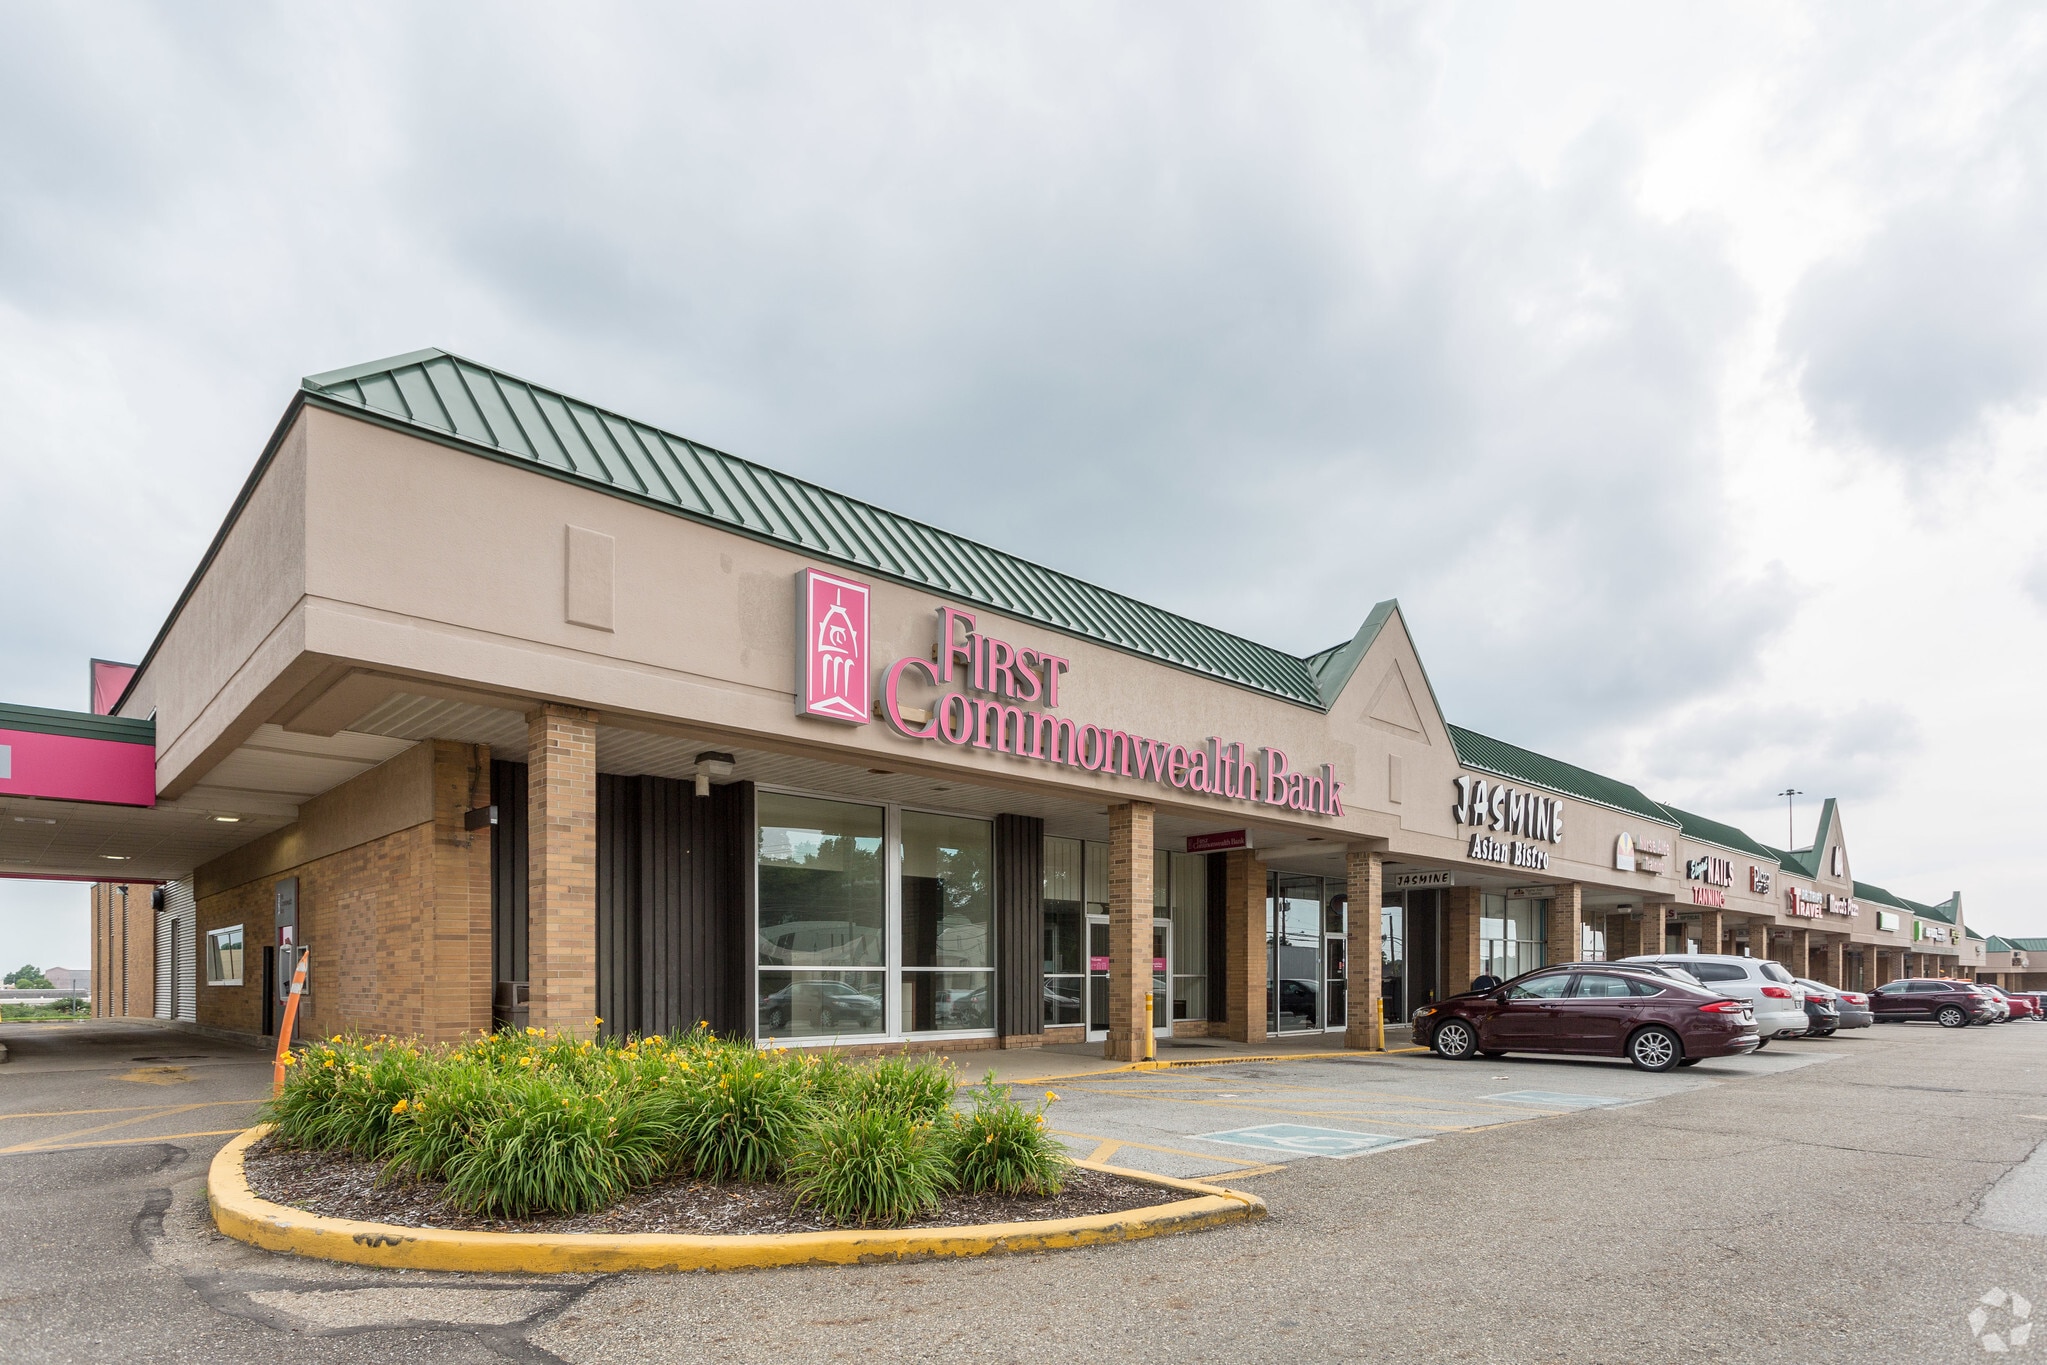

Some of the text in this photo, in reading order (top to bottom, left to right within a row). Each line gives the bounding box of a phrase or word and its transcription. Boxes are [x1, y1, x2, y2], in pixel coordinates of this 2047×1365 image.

[936, 605, 1070, 708] FIRST
[879, 655, 1347, 818] Commonwealth Bank
[1453, 774, 1564, 844] JASMINE
[1231, 837, 1245, 845] Bank
[1468, 832, 1550, 871] Asian Bistro
[1397, 872, 1449, 887] JASMINE
[1705, 855, 1734, 887] NAILS
[1692, 886, 1725, 907] TANNING
